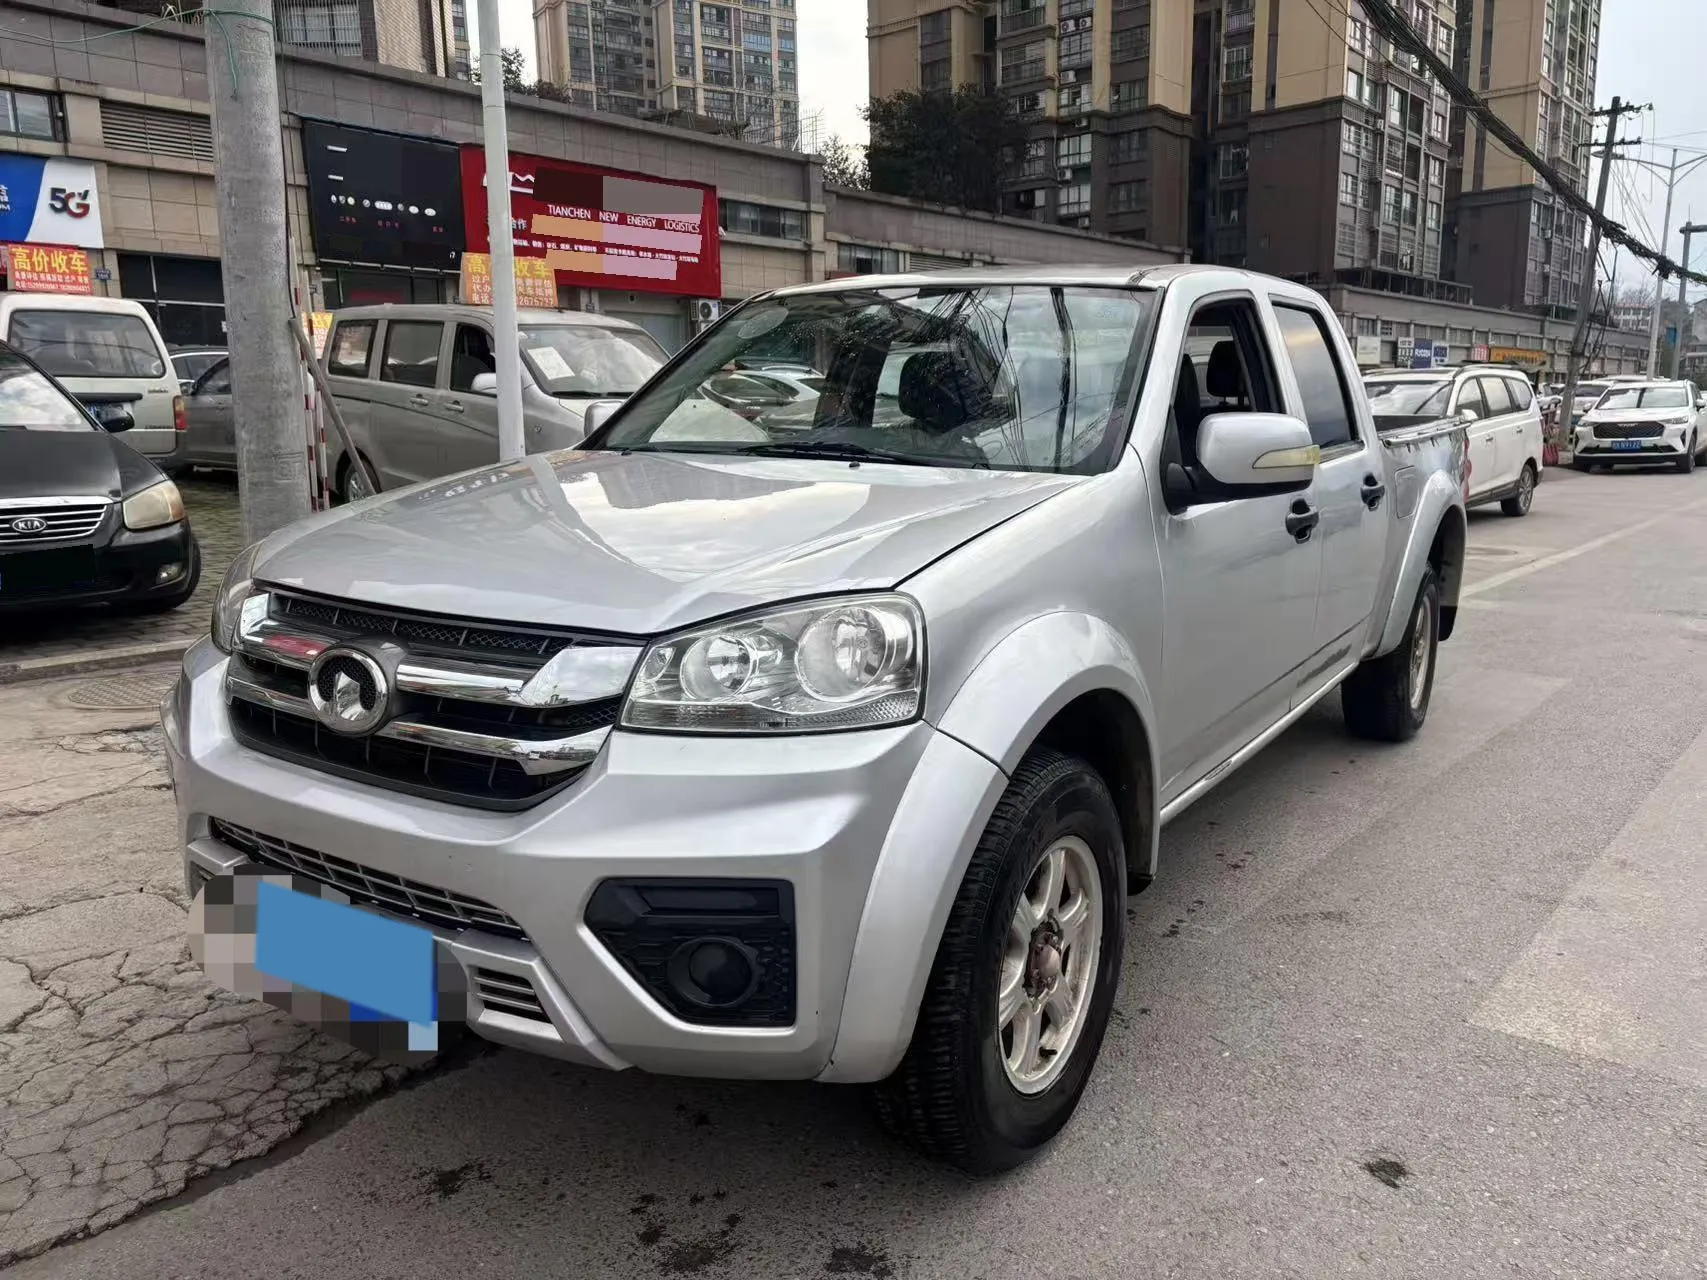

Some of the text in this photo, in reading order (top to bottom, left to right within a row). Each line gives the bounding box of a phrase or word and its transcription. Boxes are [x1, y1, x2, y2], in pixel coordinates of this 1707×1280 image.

[49, 187, 91, 219] 5G
[547, 204, 700, 234] TIANCHEN NEW ENERGY LOGISTICS
[12, 247, 88, 274] 高价收车
[18, 521, 41, 530] KIA
